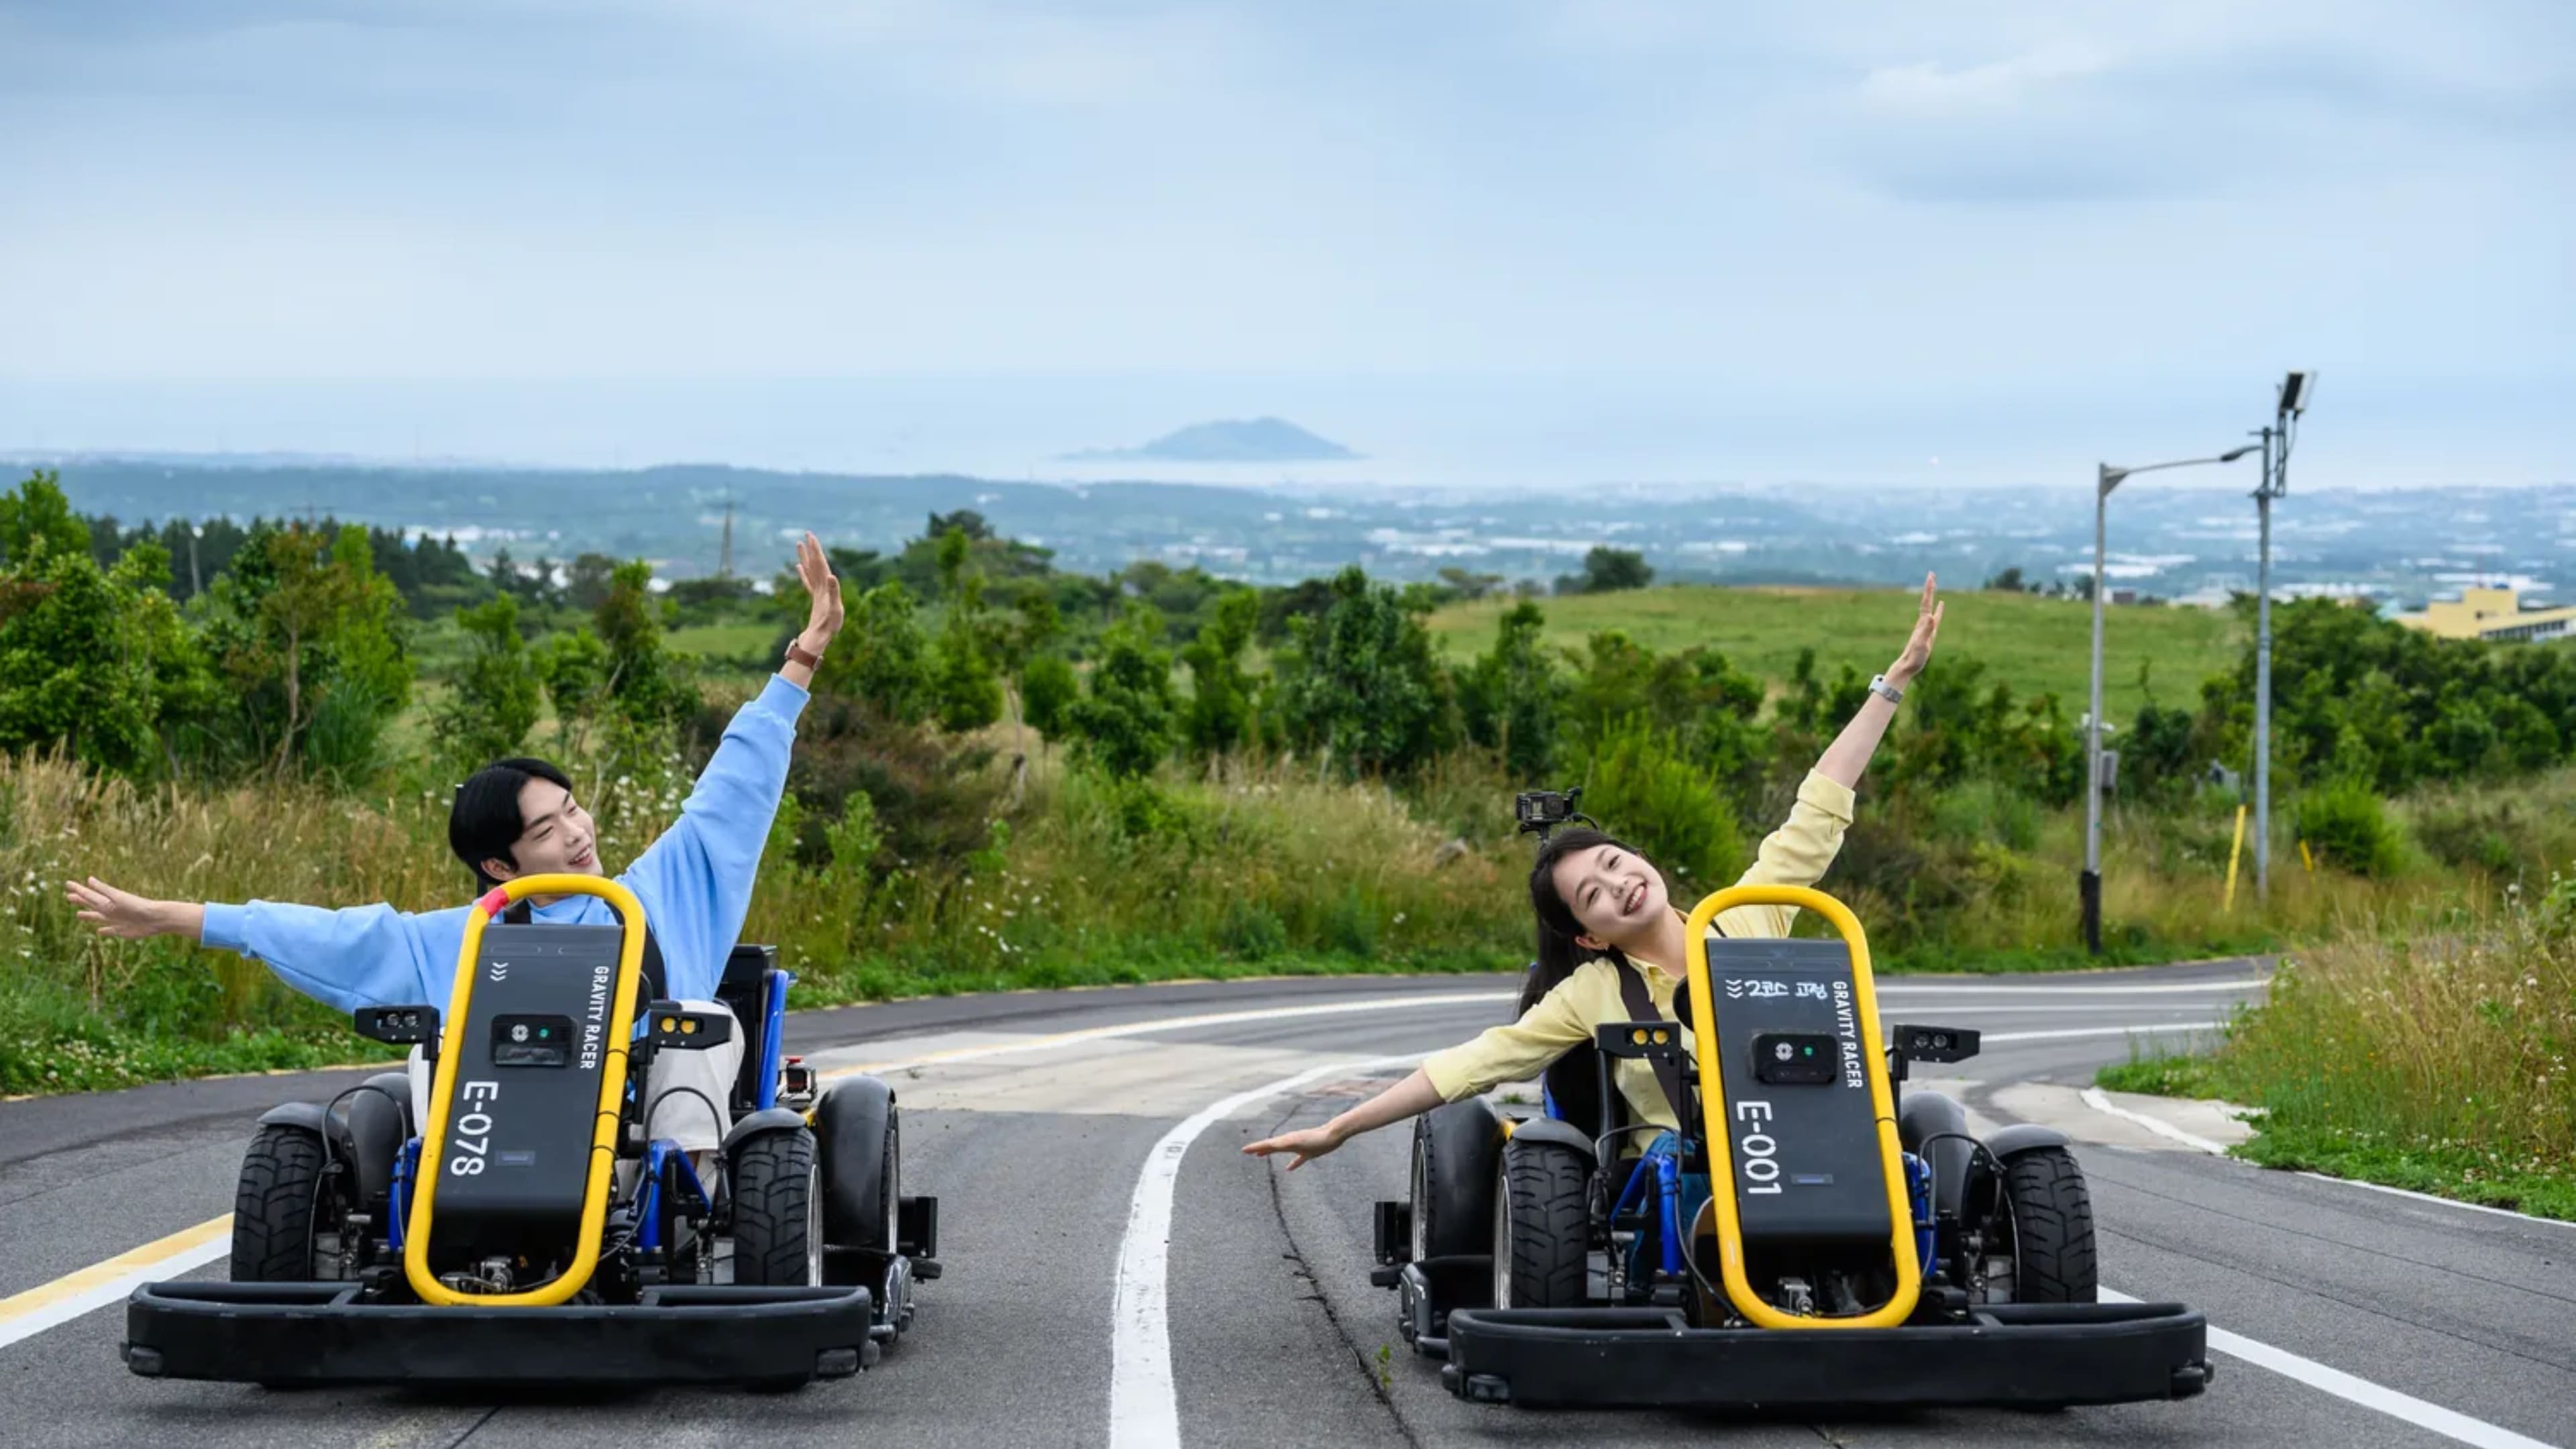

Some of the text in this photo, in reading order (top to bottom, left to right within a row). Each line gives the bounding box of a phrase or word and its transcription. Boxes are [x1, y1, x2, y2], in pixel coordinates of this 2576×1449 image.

[580, 965, 610, 1069] GRAVITY RACER
[1832, 981, 1863, 1088] GRAVITY RACER
[450, 1081, 499, 1176] E-078
[1736, 1101, 1782, 1194] E-001
